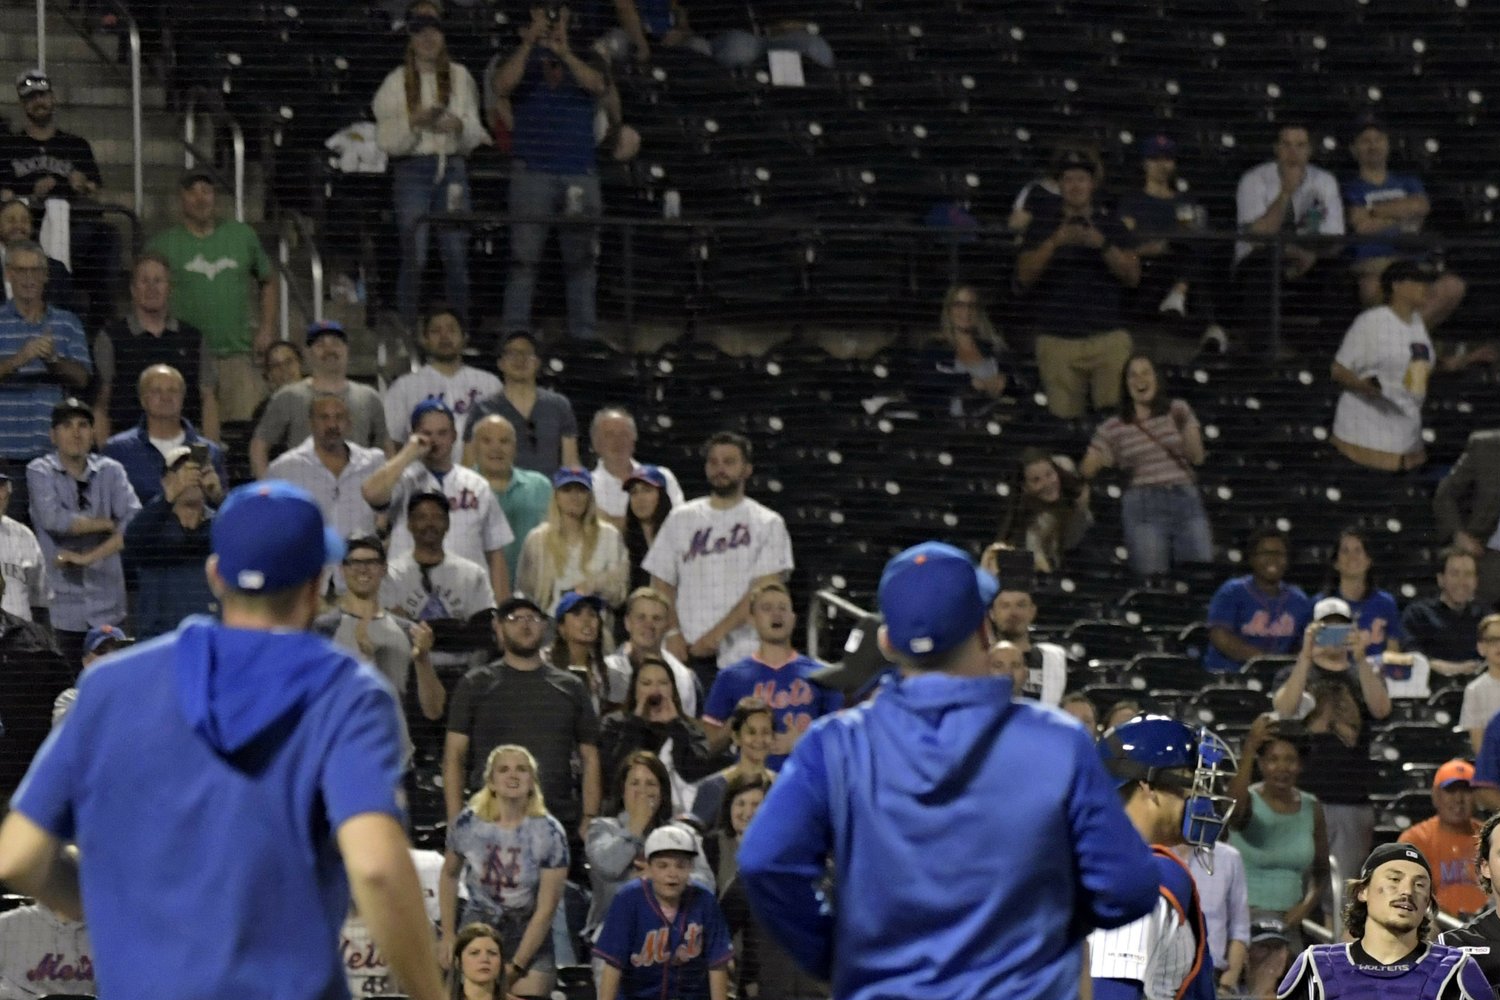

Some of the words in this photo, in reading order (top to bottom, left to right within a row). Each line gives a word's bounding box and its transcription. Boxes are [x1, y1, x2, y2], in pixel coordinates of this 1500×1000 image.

[683, 522, 751, 562] Mets
[753, 679, 813, 709] Mets
[1359, 963, 1410, 972] WOLTERS
